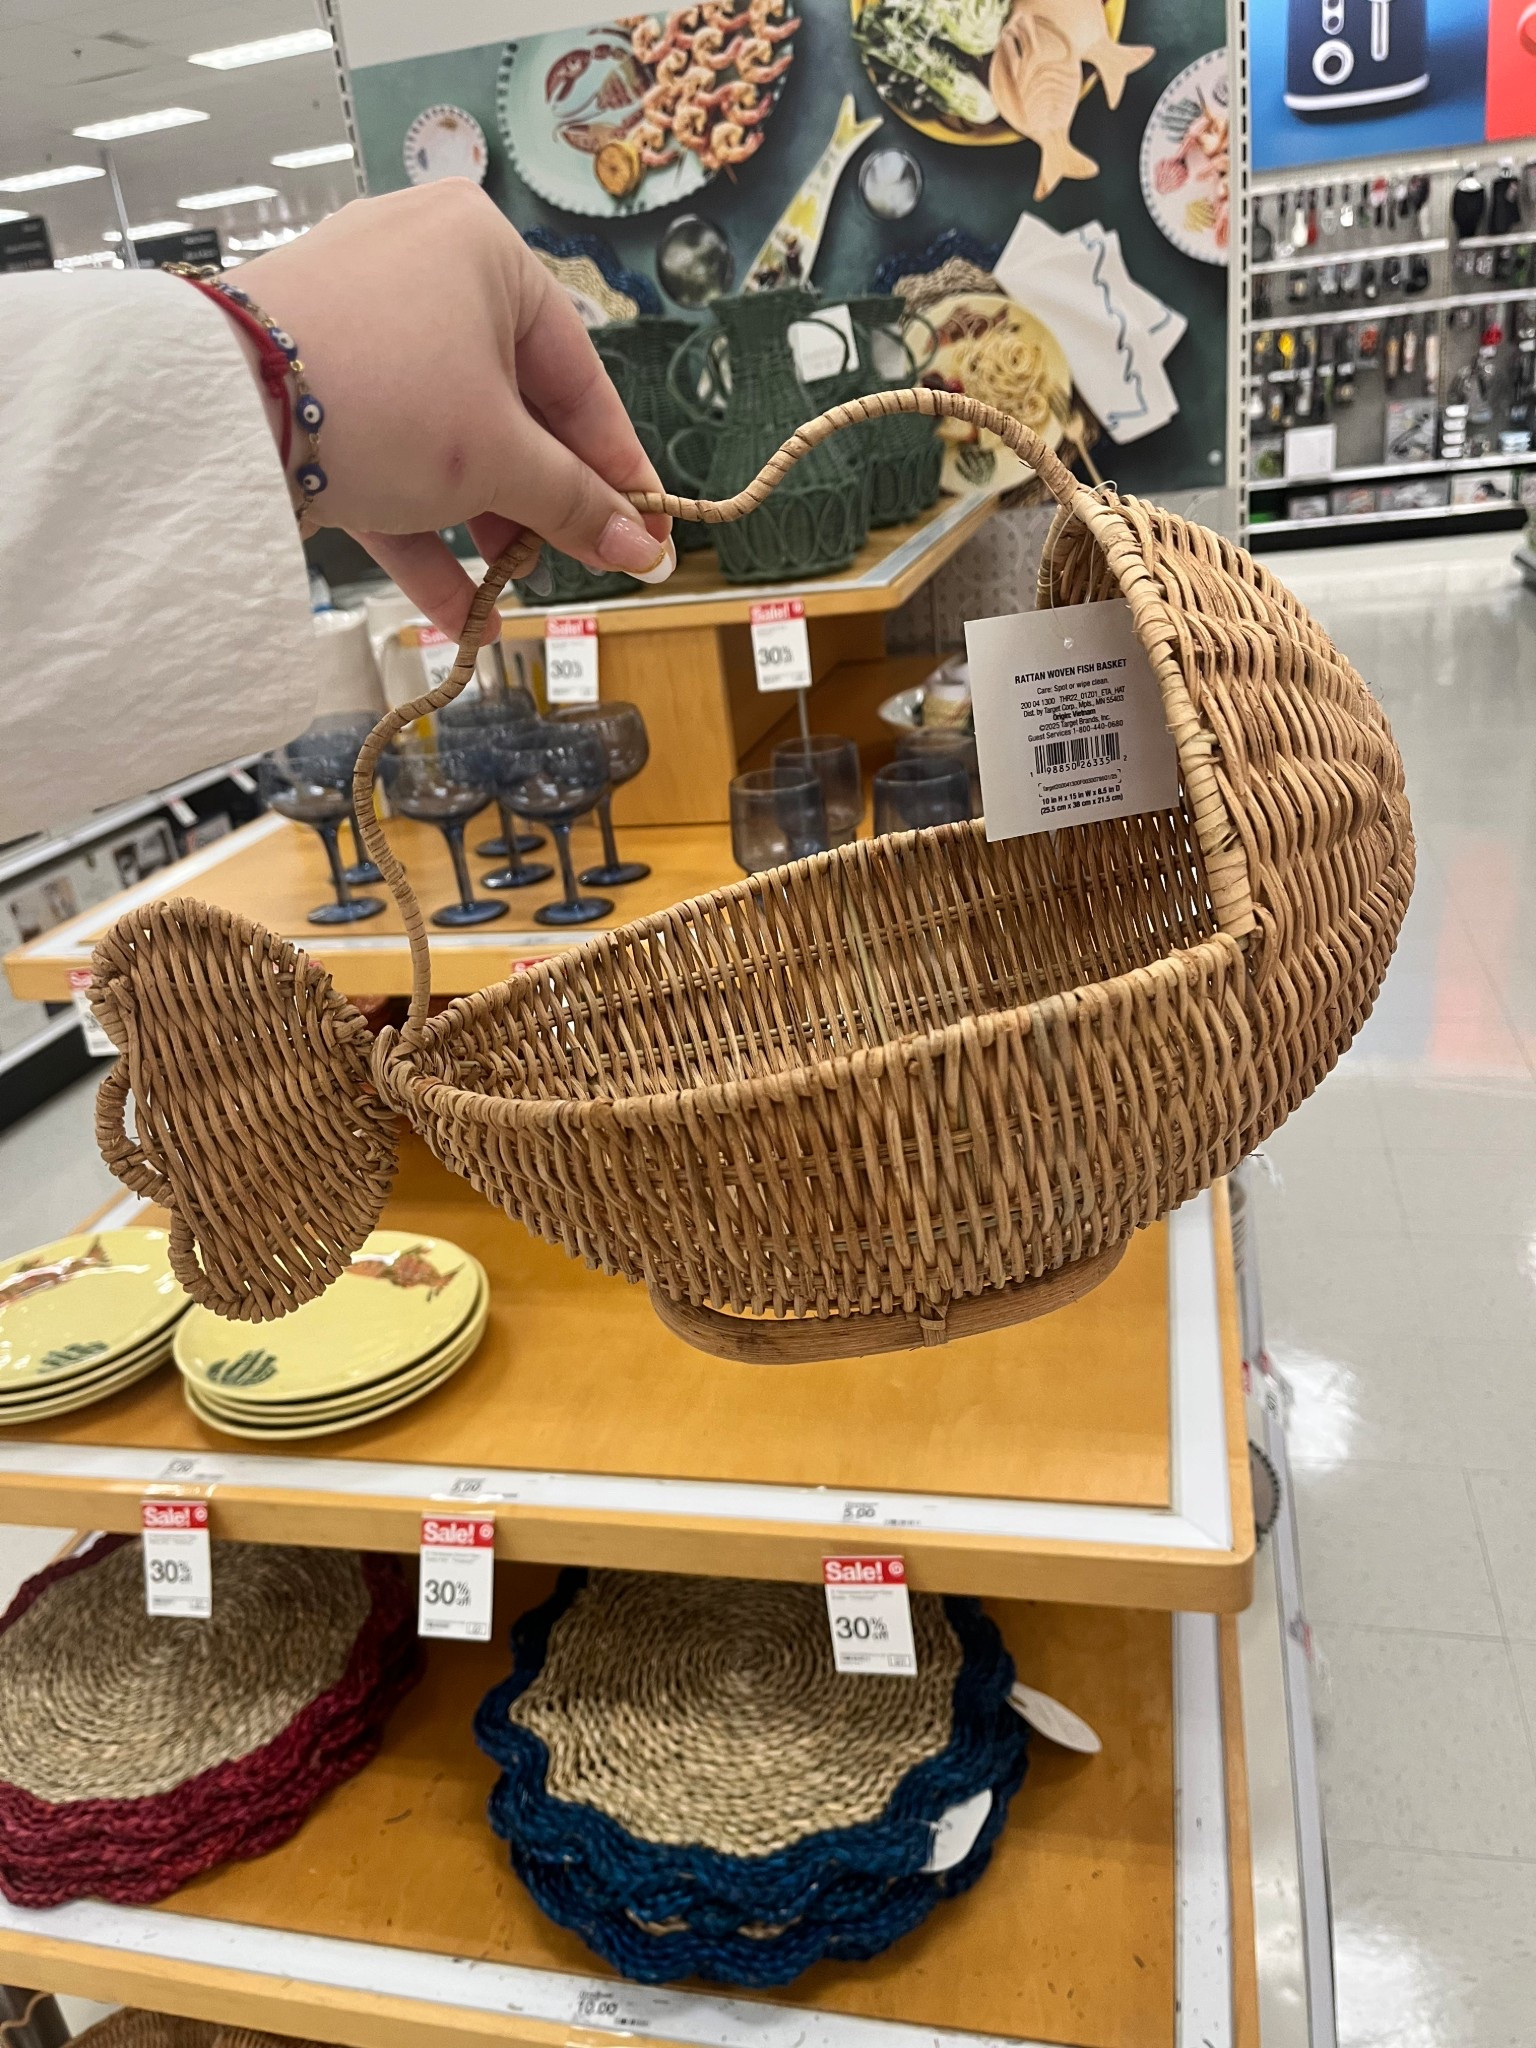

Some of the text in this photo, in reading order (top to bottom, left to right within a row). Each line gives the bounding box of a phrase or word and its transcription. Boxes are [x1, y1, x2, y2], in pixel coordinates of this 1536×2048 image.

[1015, 658, 1127, 684] RATTAN WOVEN FISH BASKET
[1037, 686, 1052, 694] Care:
[1054, 683, 1068, 692] Spot
[1076, 680, 1091, 689] wipe
[1092, 677, 1110, 686] clean.
[1020, 702, 1032, 710] 200
[1032, 700, 1040, 708] 04
[1041, 698, 1056, 706] 1300
[1024, 710, 1035, 718] Dist.
[1044, 706, 1061, 714] Target
[1095, 697, 1106, 706] MN
[1106, 694, 1125, 704] 55403
[1072, 708, 1096, 718] Vietnam
[1061, 719, 1078, 729] Target
[1028, 734, 1046, 742] Guest
[1046, 729, 1072, 740] Services
[1070, 792, 1077, 800] 15
[1084, 789, 1092, 797] W
[1098, 786, 1108, 795] 8.5
[1040, 804, 1056, 816] (25.5
[1056, 804, 1067, 812] cm
[1072, 800, 1080, 808] 38
[1081, 799, 1091, 807] cm
[1098, 796, 1111, 804] 21.5
[1112, 793, 1124, 802] cm)
[144, 1505, 191, 1528] Sale!
[423, 1520, 475, 1546] Sale!
[825, 1561, 885, 1582] Sale!
